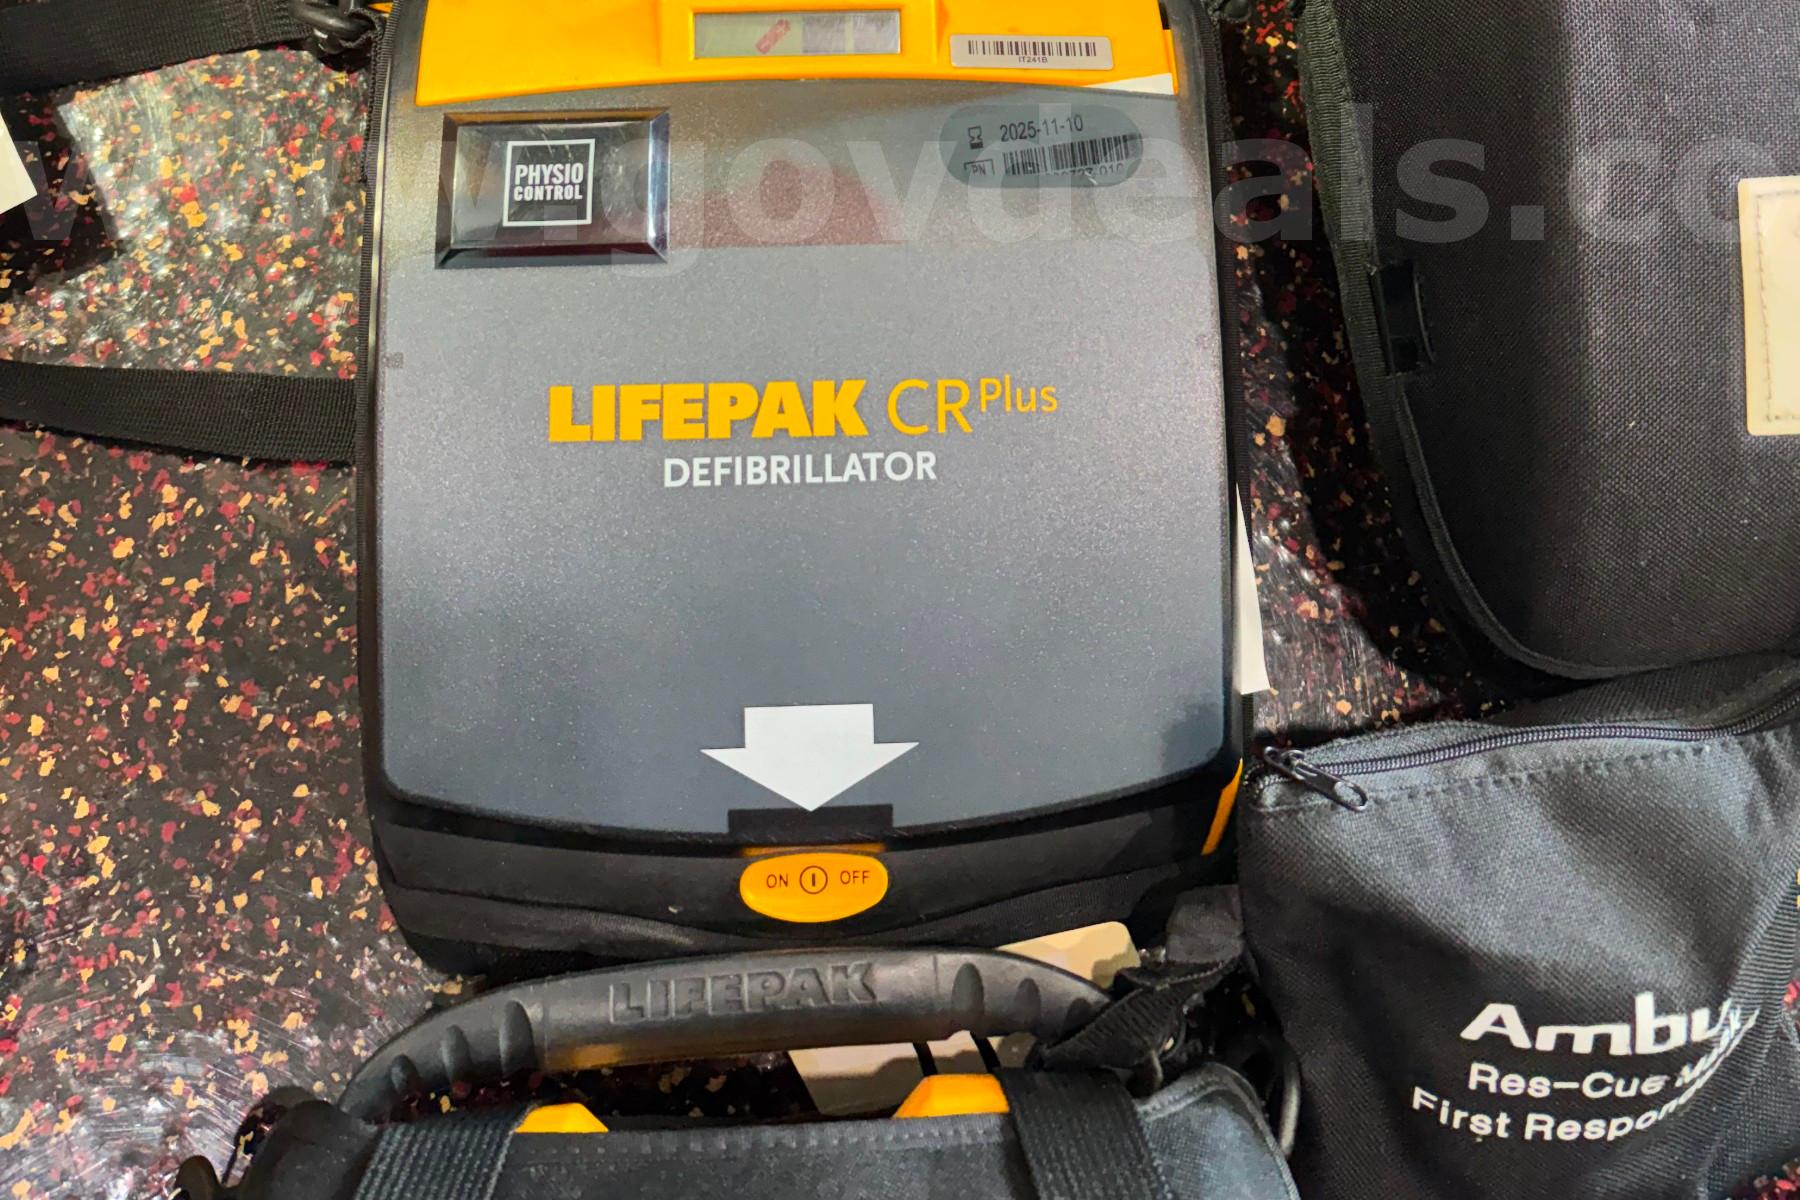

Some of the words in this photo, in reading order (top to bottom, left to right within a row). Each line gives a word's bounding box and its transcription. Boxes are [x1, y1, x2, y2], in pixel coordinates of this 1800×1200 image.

[1000, 114, 1084, 142] 2025-11-10
[514, 162, 584, 186] PHYSIO
[513, 184, 583, 202] CONTROL
[549, 379, 868, 442] LIFEPAK
[663, 450, 937, 488] DEFIBRILLATOR
[766, 873, 789, 888] ON
[839, 870, 870, 885] OFF
[609, 961, 878, 1024] LIFEPAK
[1468, 1062, 1668, 1099] Res-Cue
[1411, 1086, 1512, 1140] First
